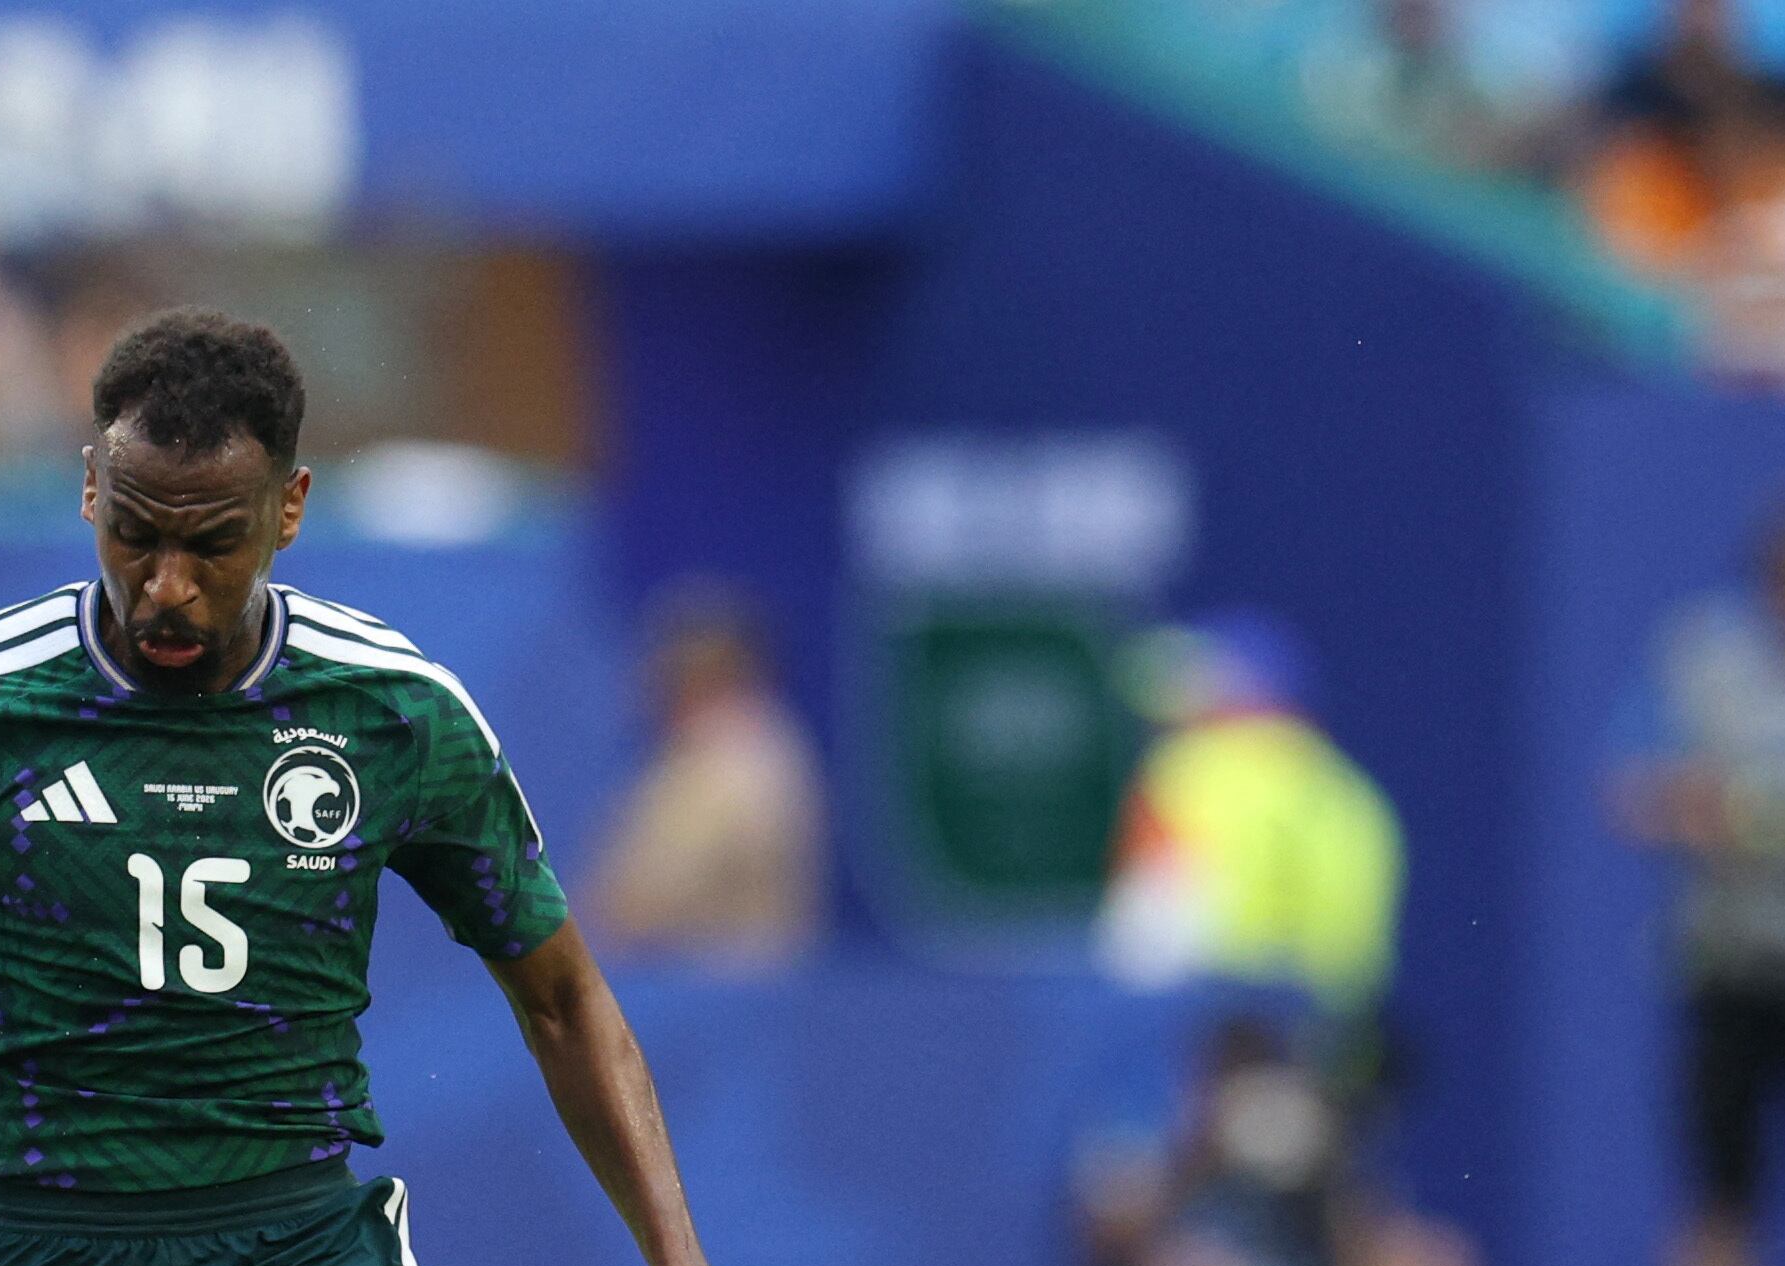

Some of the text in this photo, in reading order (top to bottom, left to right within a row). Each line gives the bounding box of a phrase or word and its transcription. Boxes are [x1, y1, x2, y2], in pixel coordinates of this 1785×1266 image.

[272, 727, 348, 749] السعودية
[143, 783, 165, 793] SAUDI
[166, 784, 193, 794] ARABIA
[205, 786, 238, 796] URUGUAY
[314, 808, 342, 819] SAFF
[286, 853, 336, 871] SAUDI
[127, 852, 251, 994] 15
